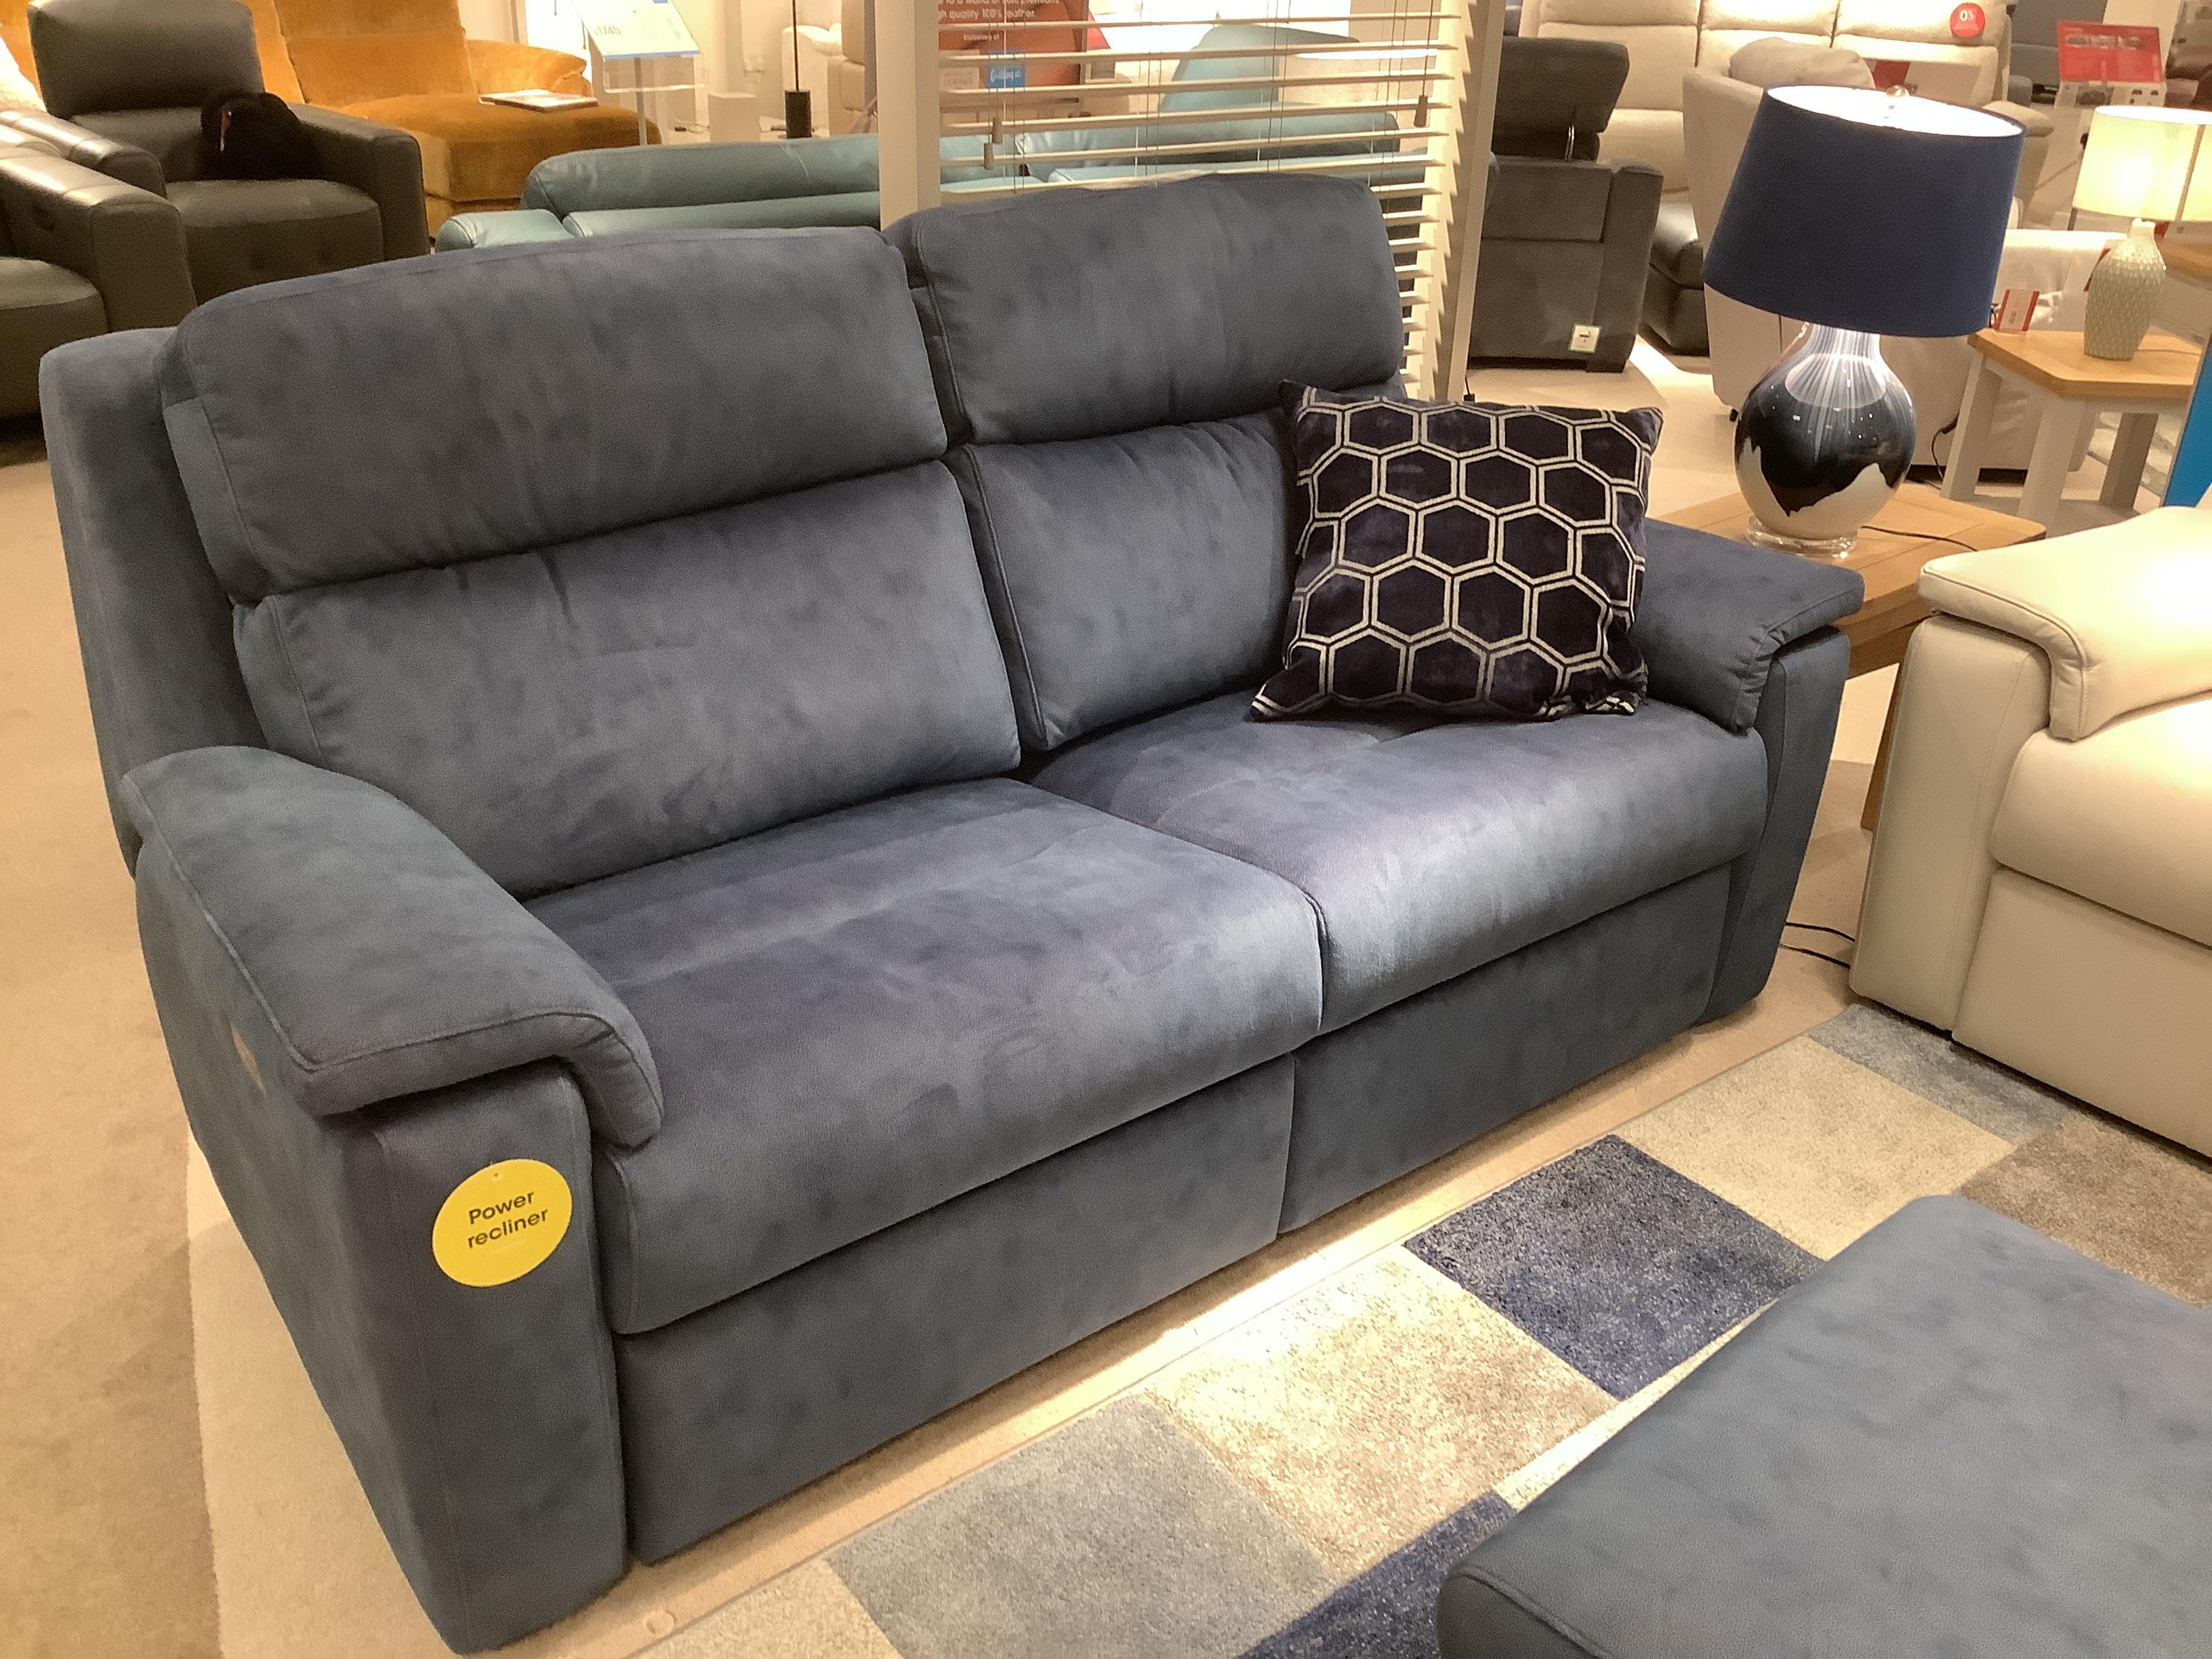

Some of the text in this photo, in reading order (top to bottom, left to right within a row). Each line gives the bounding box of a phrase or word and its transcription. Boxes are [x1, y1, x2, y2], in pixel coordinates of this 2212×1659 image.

[949, 9, 979, 20] quality
[468, 1191, 534, 1225] Power
[468, 1210, 548, 1248] recliner
